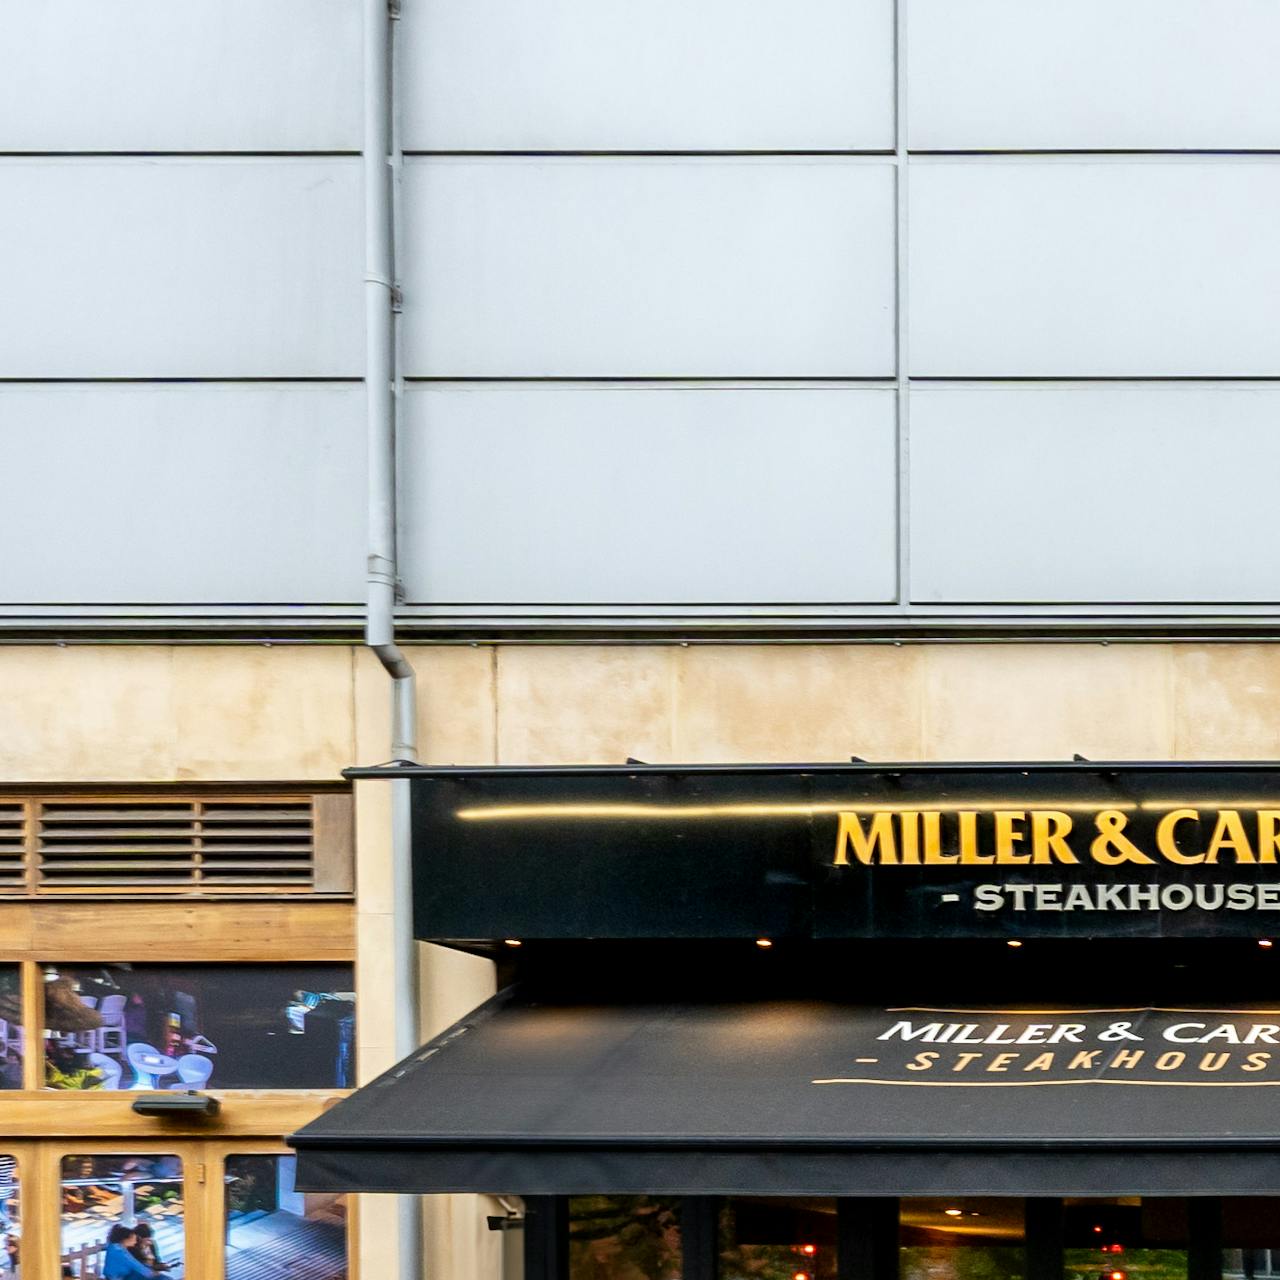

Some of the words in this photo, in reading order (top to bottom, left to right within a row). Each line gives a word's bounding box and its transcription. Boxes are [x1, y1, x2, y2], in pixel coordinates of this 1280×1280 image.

[834, 810, 1081, 865] MILLER
[1090, 809, 1160, 866] &
[876, 1021, 1087, 1044] MILLER
[1097, 1021, 1144, 1042] &
